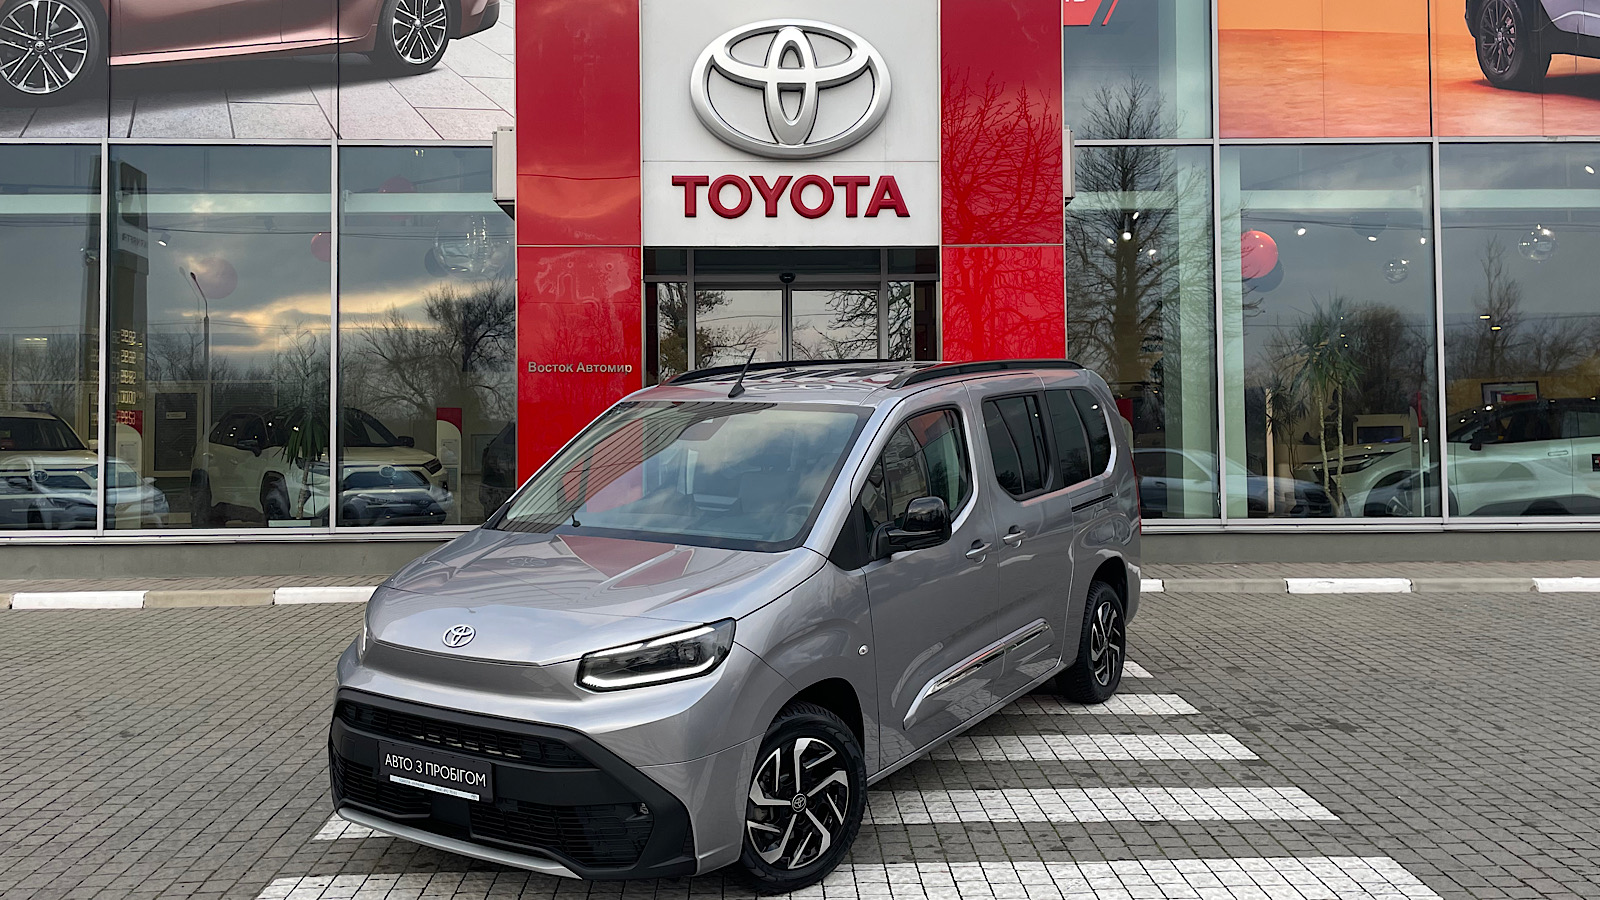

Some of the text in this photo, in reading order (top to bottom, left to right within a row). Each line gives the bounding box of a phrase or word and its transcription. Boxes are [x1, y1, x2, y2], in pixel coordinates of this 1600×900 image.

[671, 174, 911, 219] TOYOTA
[528, 361, 633, 376] Восток Автомир
[384, 753, 413, 771] АВТО
[425, 761, 487, 788] ПРОБІГОМ
